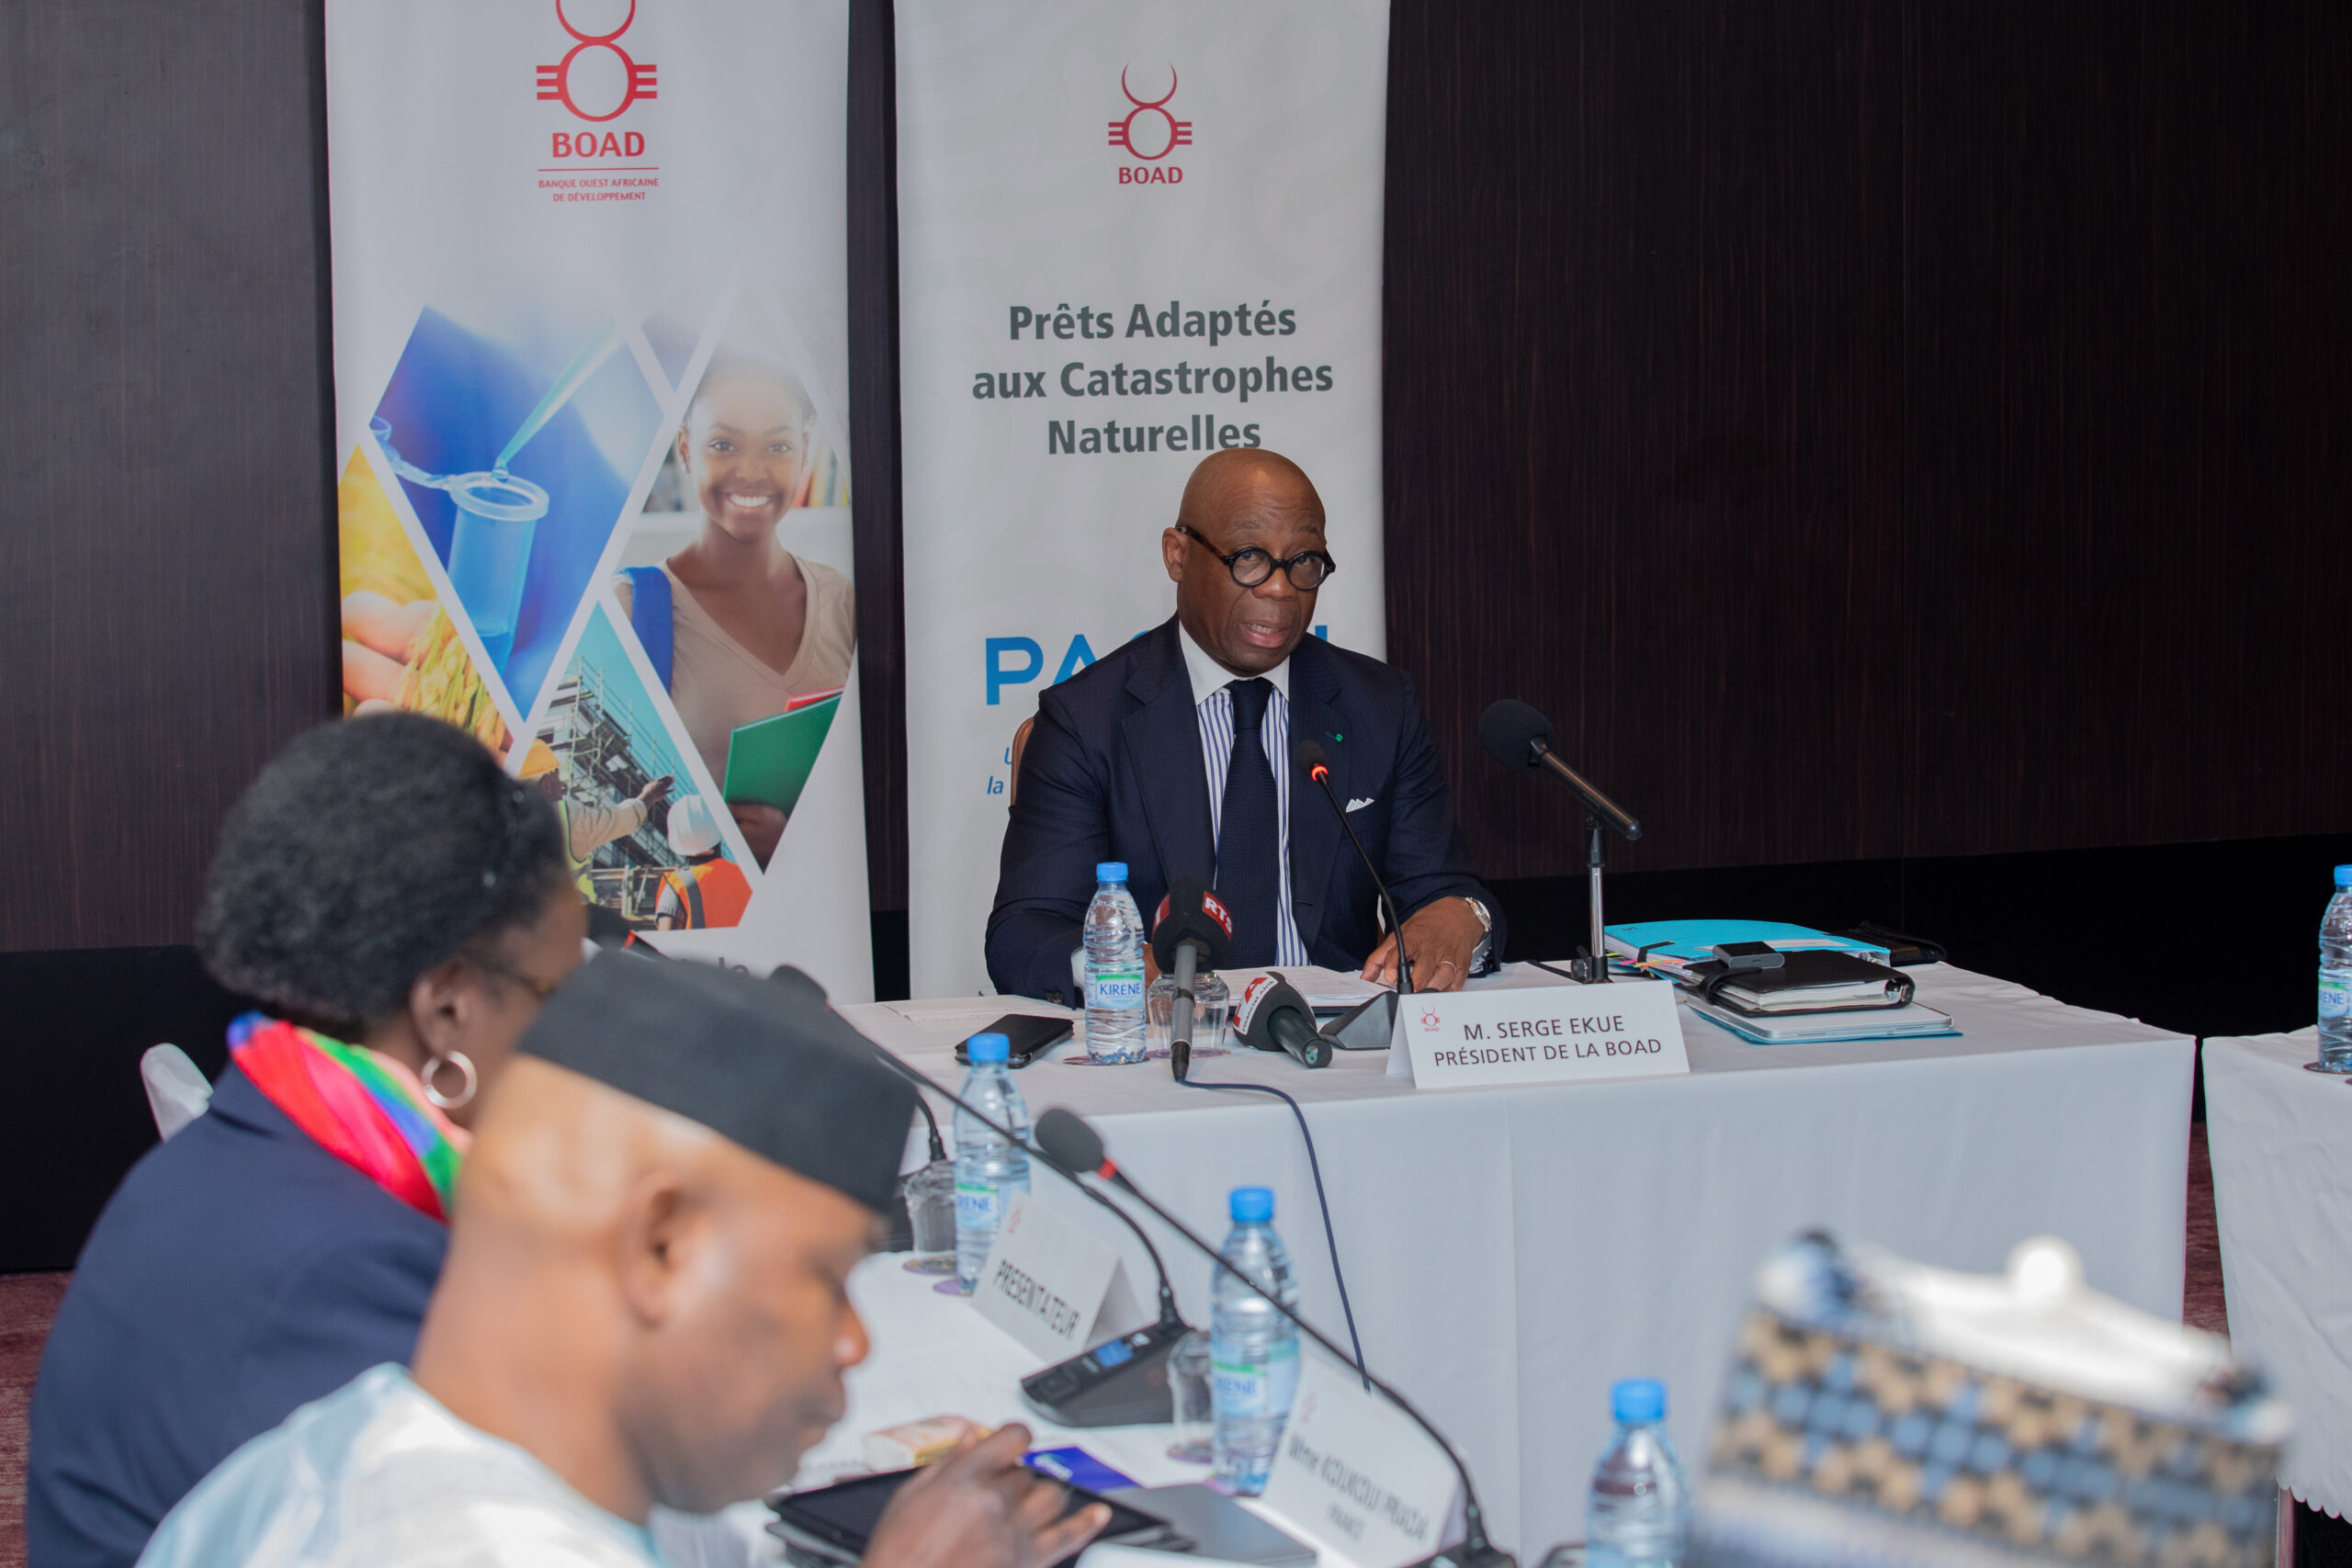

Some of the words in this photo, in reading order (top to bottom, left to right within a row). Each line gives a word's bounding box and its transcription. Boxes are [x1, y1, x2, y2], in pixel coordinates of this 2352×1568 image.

[552, 131, 645, 158] BOAD
[538, 179, 577, 189] BANQUE
[579, 178, 608, 187] OUEST
[611, 177, 660, 187] AFRICAINE
[1119, 166, 1183, 185] BOAD
[553, 193, 565, 202] DE
[568, 191, 646, 202] DÉVELOPPEMENT
[1010, 303, 1114, 341] Prêts
[1125, 299, 1296, 346] Adaptés
[972, 370, 1047, 400] aux
[1060, 355, 1333, 402] Catastrophes
[1048, 414, 1261, 455] Naturelles
[987, 775, 1003, 795] la
[1205, 897, 1232, 933] RTS
[1464, 1023, 1490, 1041] M.
[1498, 1019, 1563, 1039] SERGE
[1571, 1015, 1624, 1034] EKUE
[1434, 1046, 1536, 1066] PRÉSIDENT
[1544, 1043, 1568, 1061] DE
[1576, 1042, 1600, 1059] LA
[1607, 1039, 1662, 1056] BOAD
